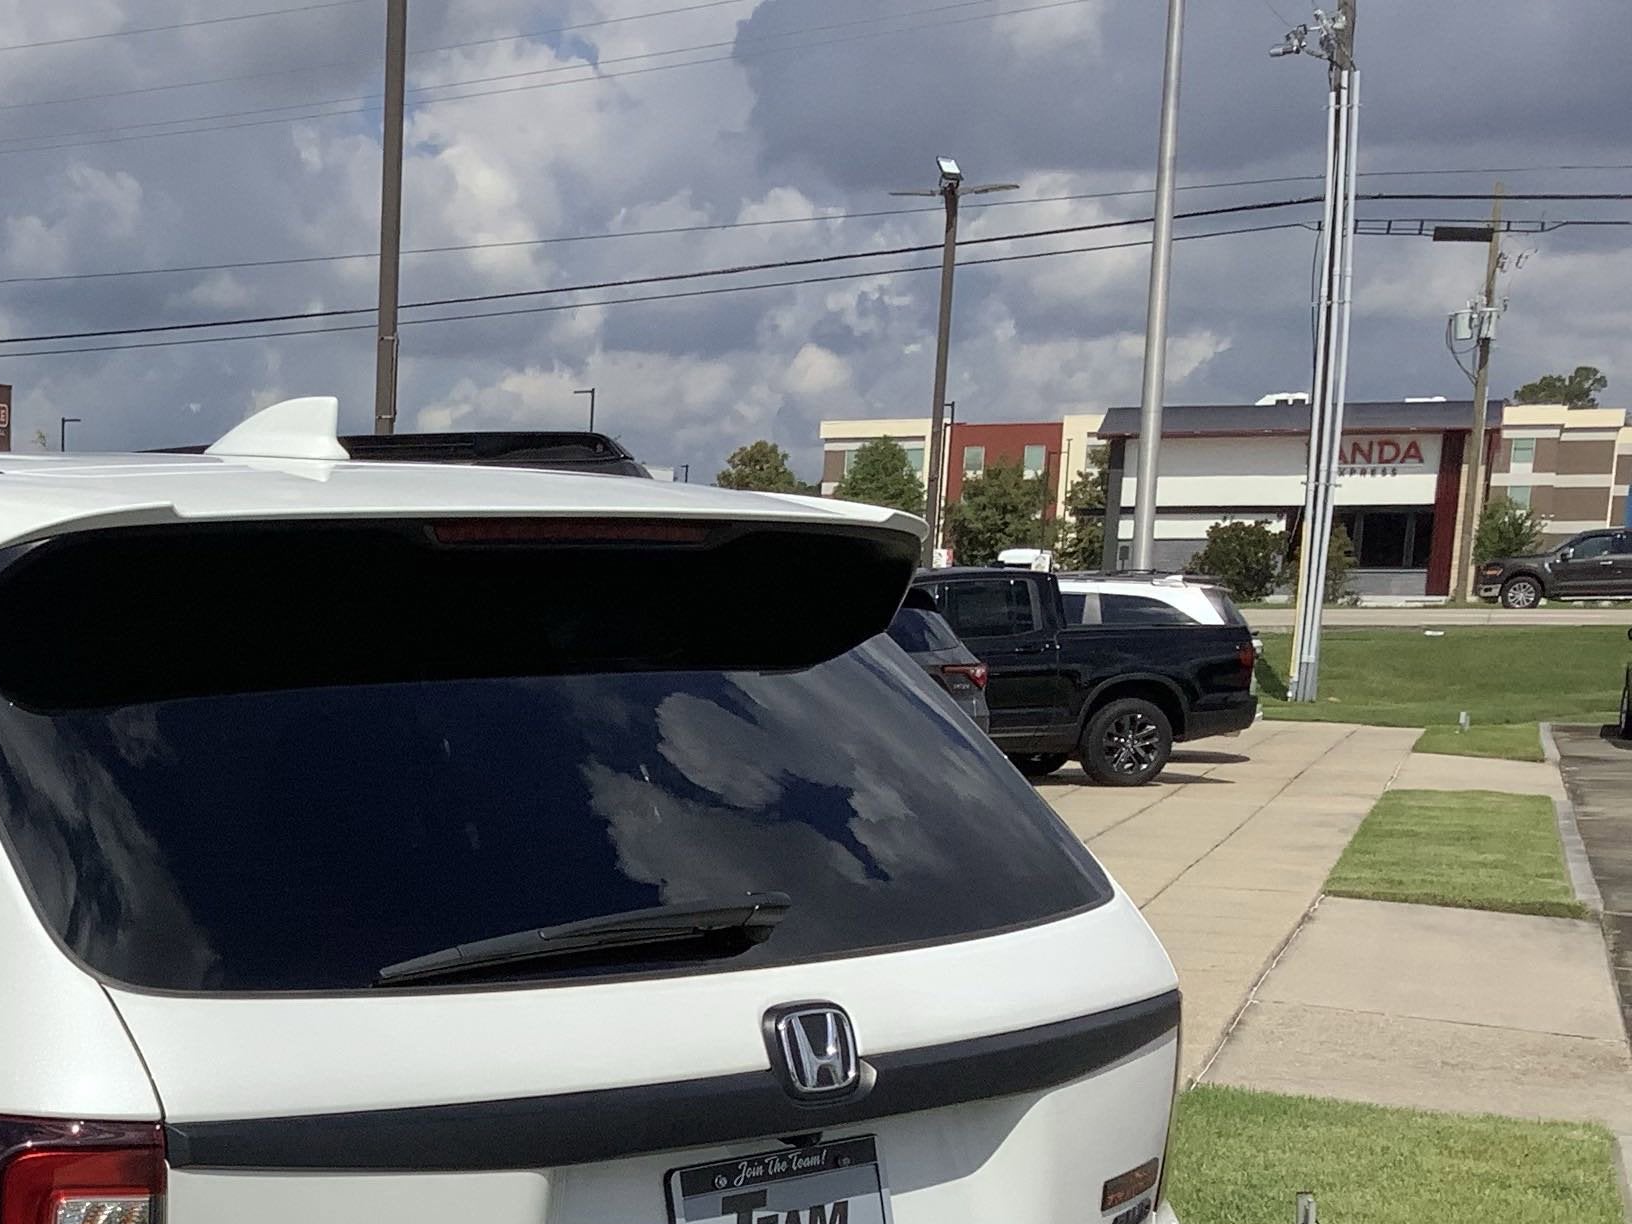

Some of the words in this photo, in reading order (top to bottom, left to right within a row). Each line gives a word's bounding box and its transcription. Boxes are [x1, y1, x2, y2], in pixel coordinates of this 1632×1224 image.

[1337, 467, 1397, 477] XPRESS
[734, 1161, 765, 1186] Join
[765, 1155, 789, 1176] The
[789, 1149, 827, 1171] Team!
